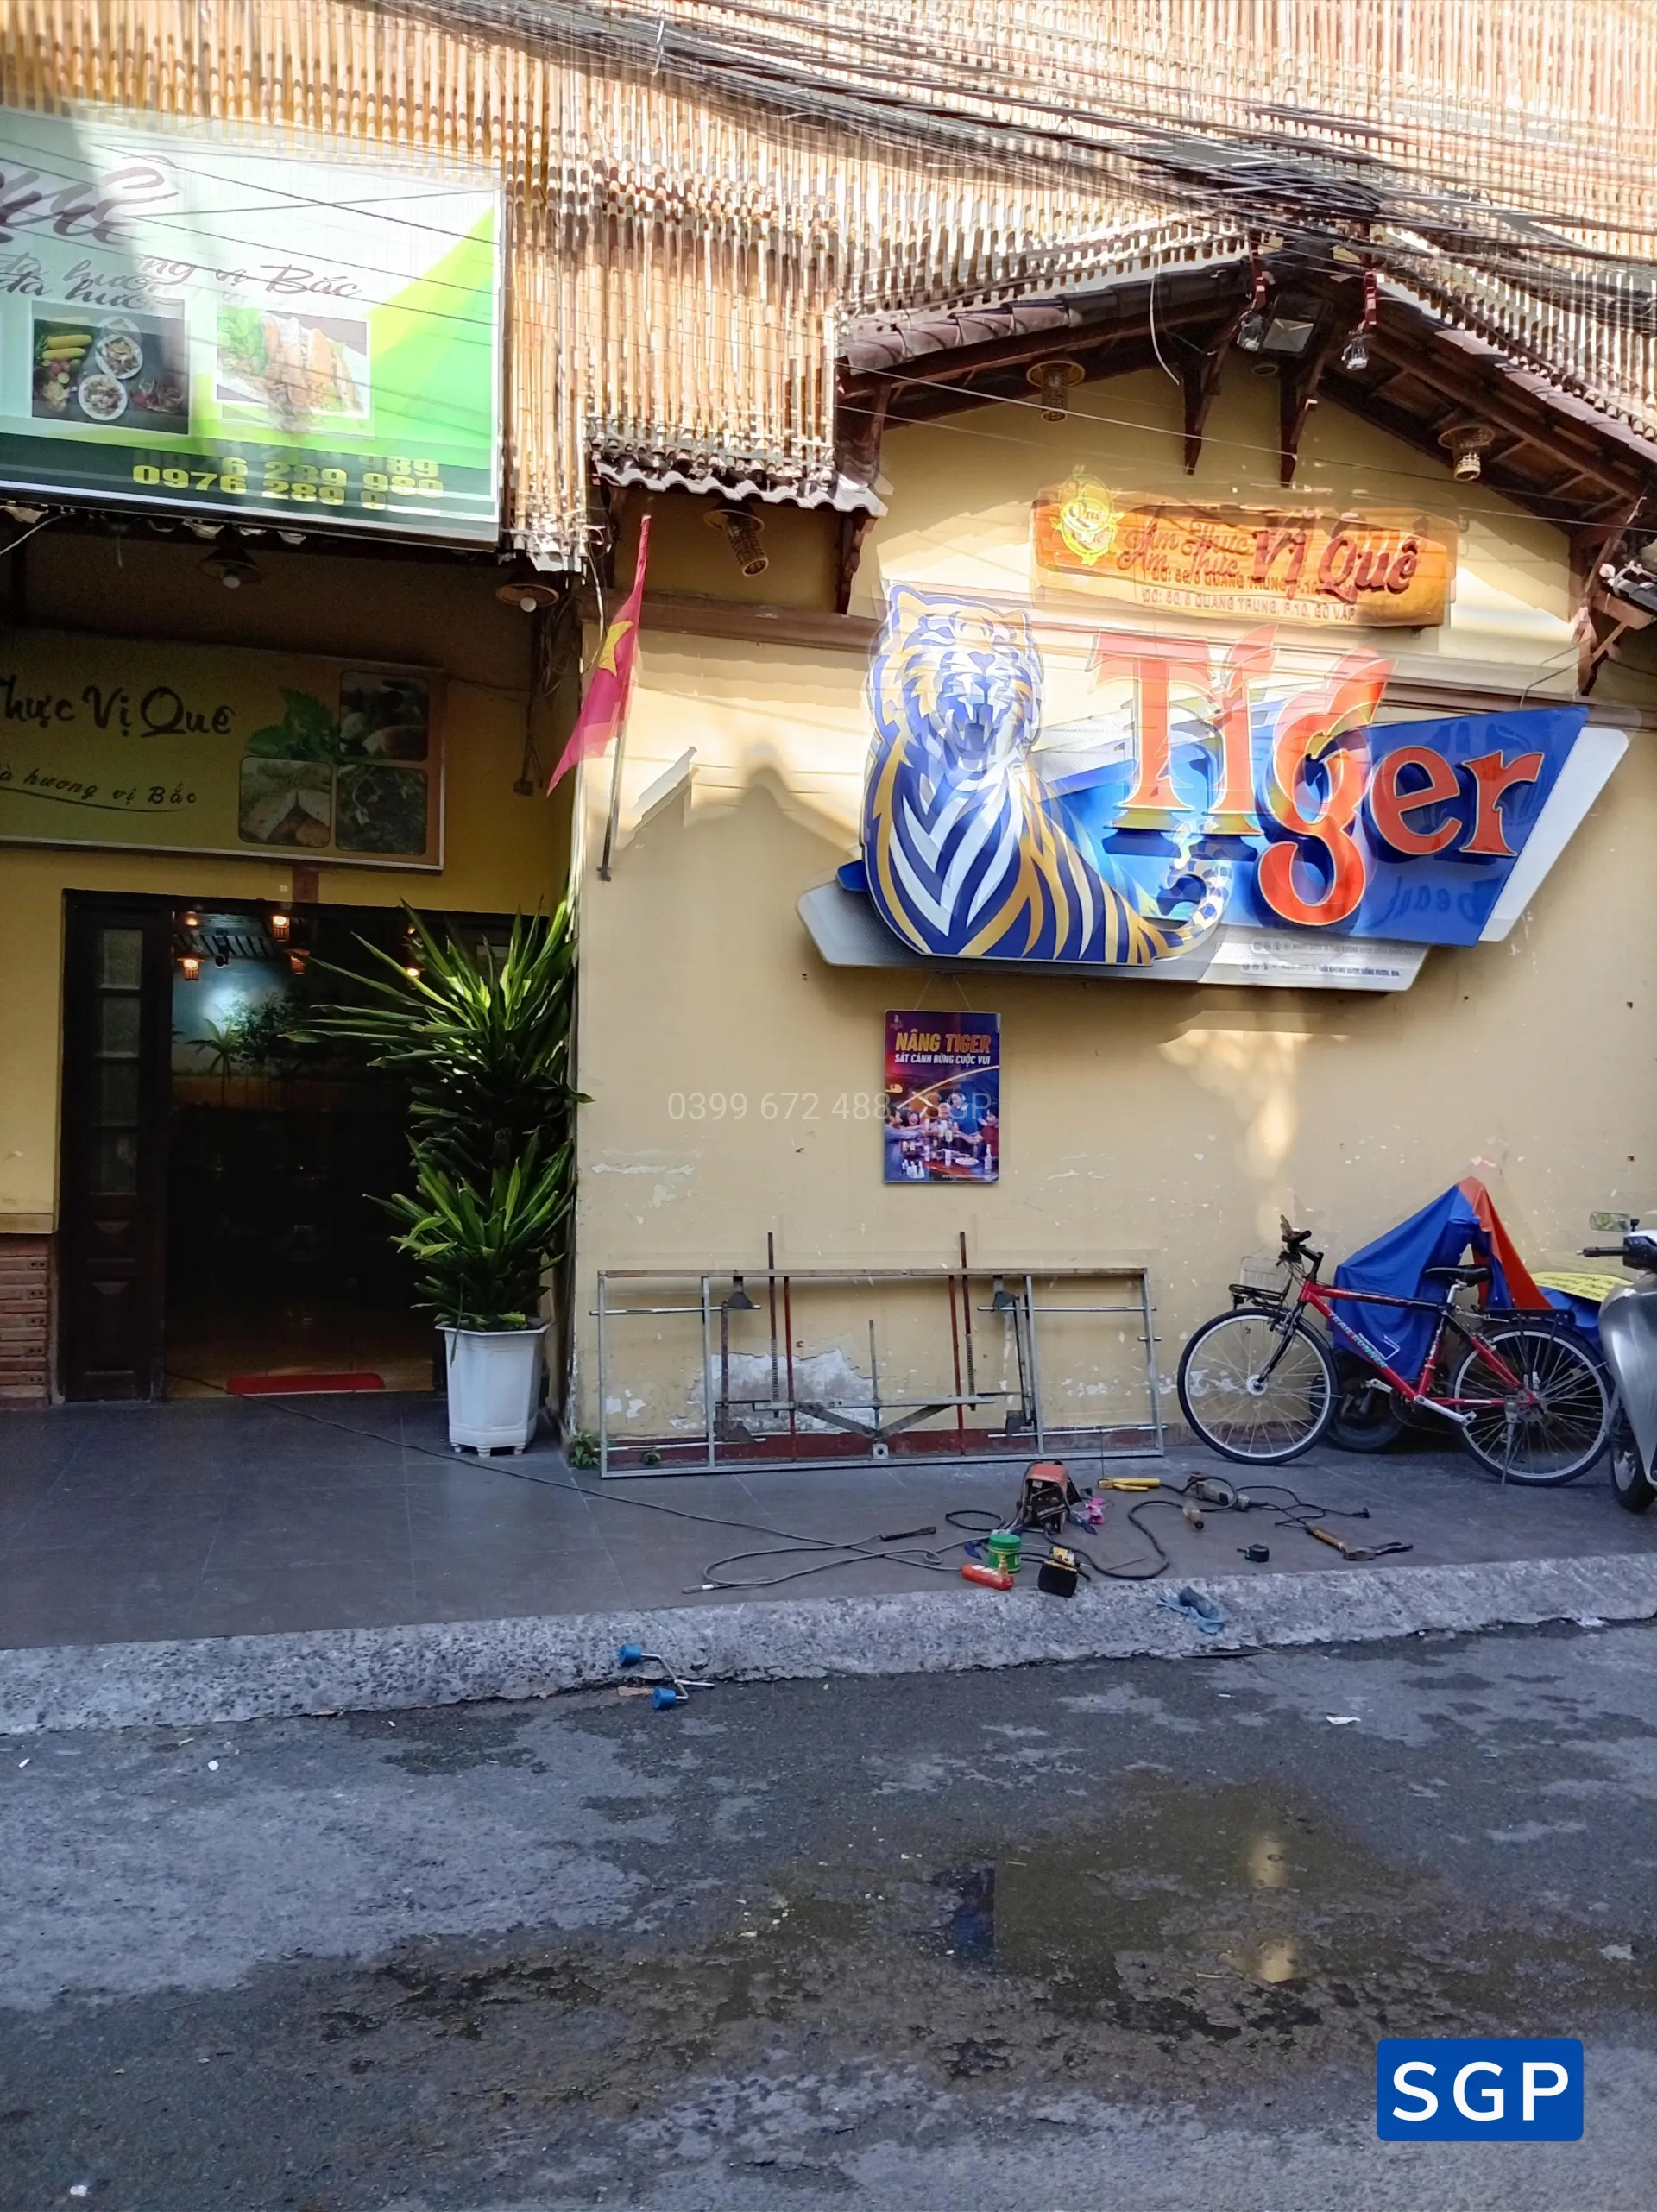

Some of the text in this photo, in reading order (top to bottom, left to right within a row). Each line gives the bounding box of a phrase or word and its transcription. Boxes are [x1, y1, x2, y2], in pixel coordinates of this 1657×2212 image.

[132, 458, 249, 495] 0976
[261, 465, 347, 507] 289
[1251, 528, 1307, 601] Vị
[1315, 535, 1418, 605] Quê
[82, 684, 132, 737] Vị
[140, 685, 236, 738] Quê
[23, 767, 98, 800] hương
[113, 786, 135, 805] vị
[148, 782, 198, 804] Bắc
[1090, 623, 1545, 926] Tiger
[894, 1028, 992, 1054] NÂNG TIGER
[894, 1051, 910, 1063] SÁT
[910, 1051, 932, 1063] CÁNH
[955, 1053, 976, 1067] CUỘC
[977, 1055, 991, 1065] VUI
